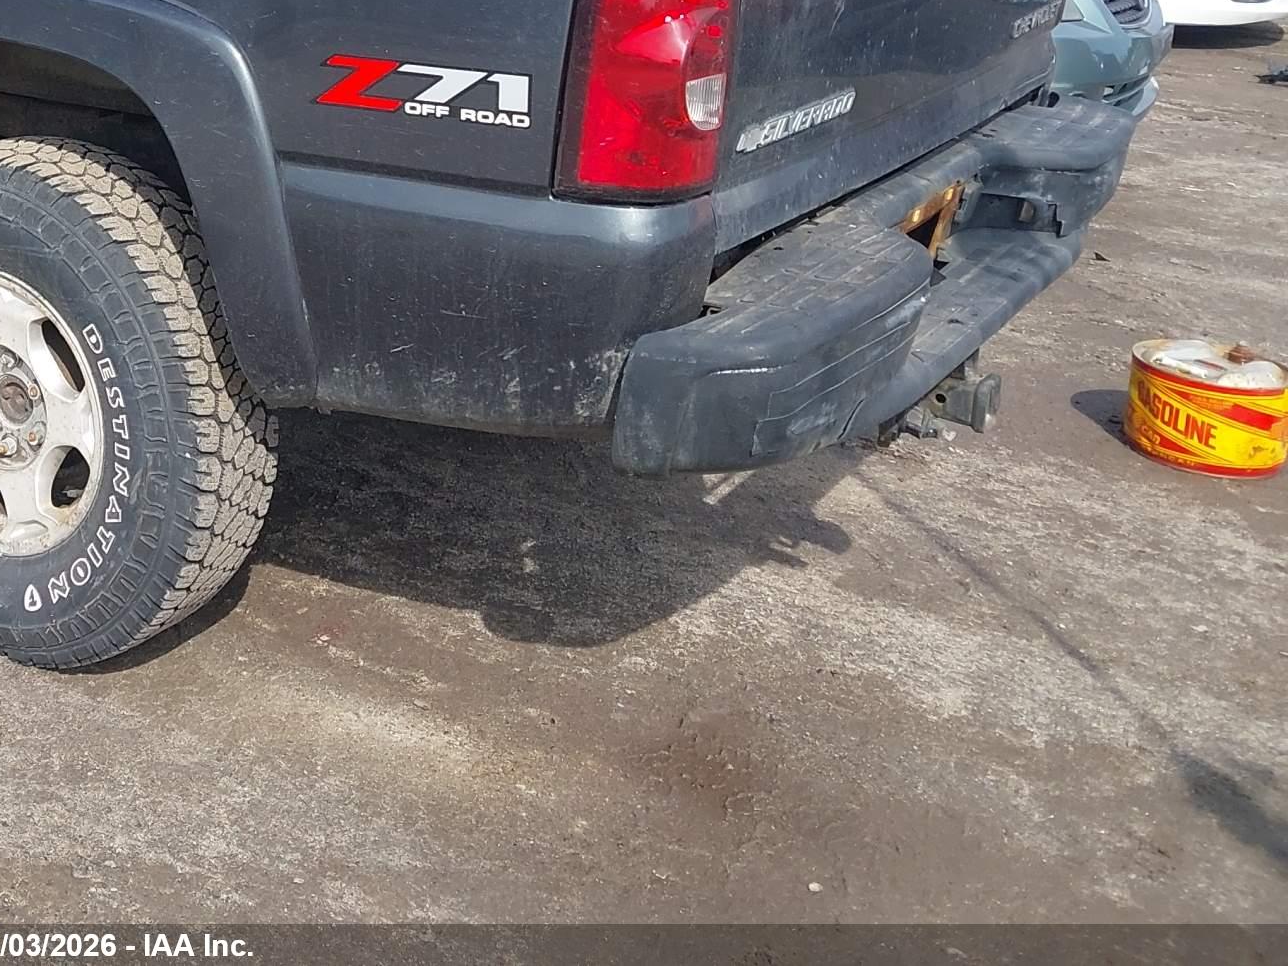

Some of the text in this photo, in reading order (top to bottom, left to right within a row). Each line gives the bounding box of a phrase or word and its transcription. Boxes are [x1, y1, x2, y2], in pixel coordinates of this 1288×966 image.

[315, 53, 530, 113] Z71
[403, 101, 531, 129] OFF ROAD
[760, 91, 856, 145] SILVERADO
[1137, 380, 1218, 450] GASOLINE
[49, 323, 130, 603] DESTINATION
